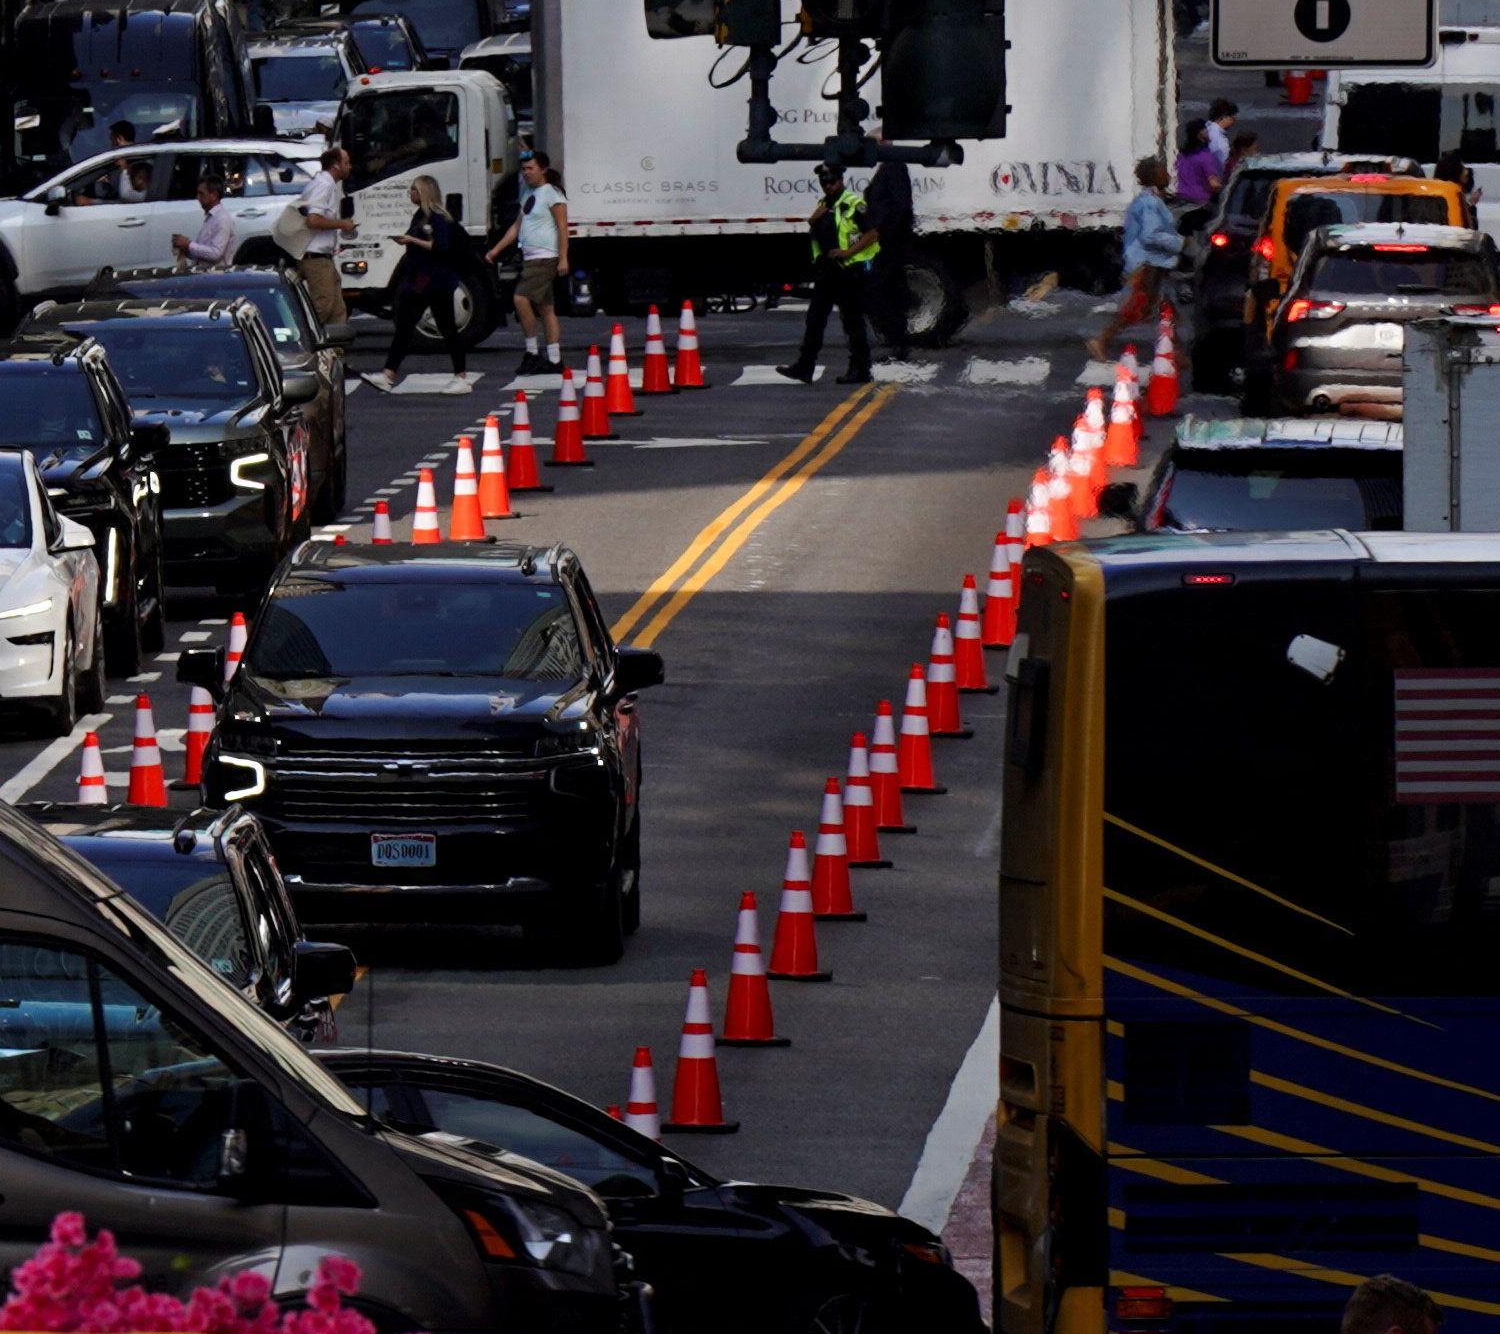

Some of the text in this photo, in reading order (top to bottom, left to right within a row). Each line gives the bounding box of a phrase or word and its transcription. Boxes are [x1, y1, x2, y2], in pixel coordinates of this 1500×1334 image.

[580, 180, 720, 194] CLASSIC BRASS
[764, 176, 818, 195] ROCK
